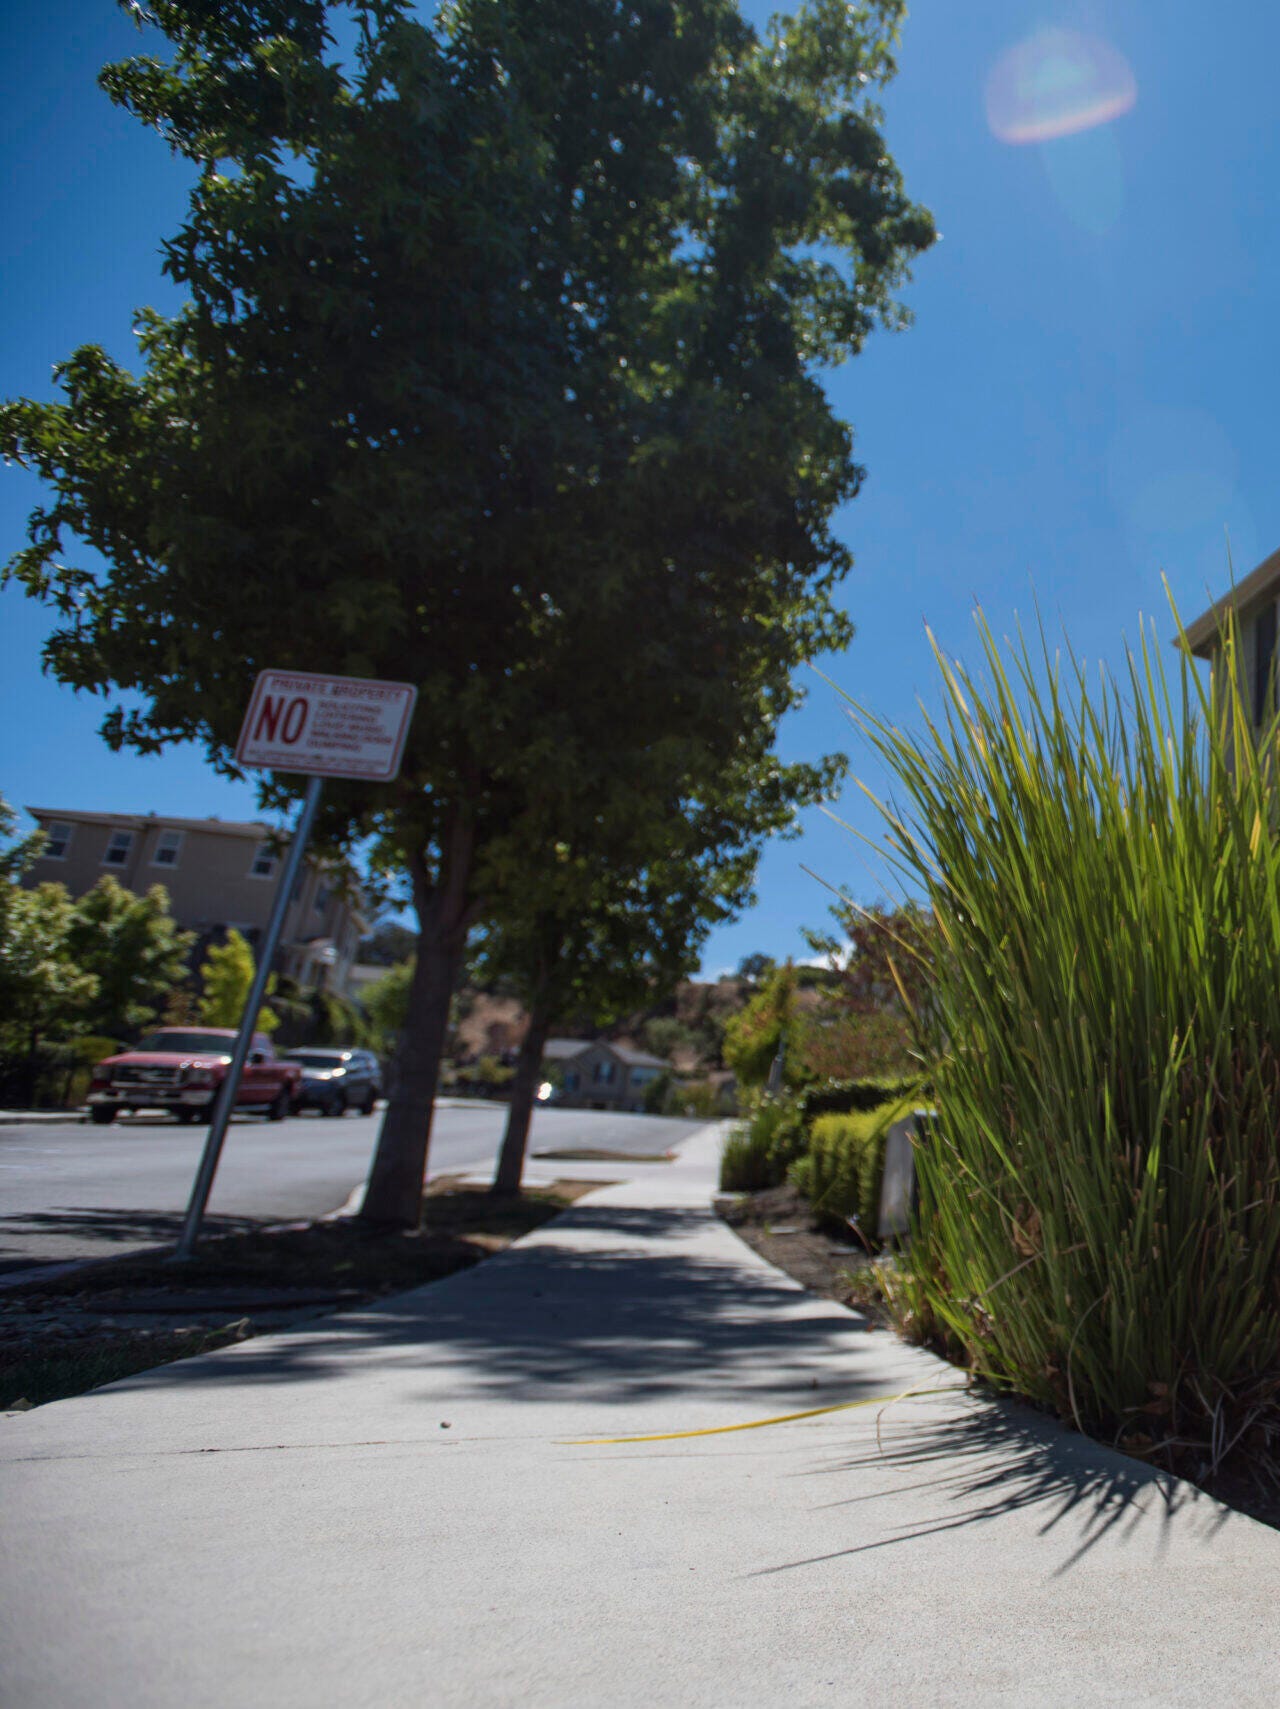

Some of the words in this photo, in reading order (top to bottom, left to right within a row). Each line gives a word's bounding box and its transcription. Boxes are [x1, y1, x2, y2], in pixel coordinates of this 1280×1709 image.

[271, 678, 327, 695] PRIVATE
[331, 684, 401, 701] PROPERTY
[253, 695, 308, 744] NO
